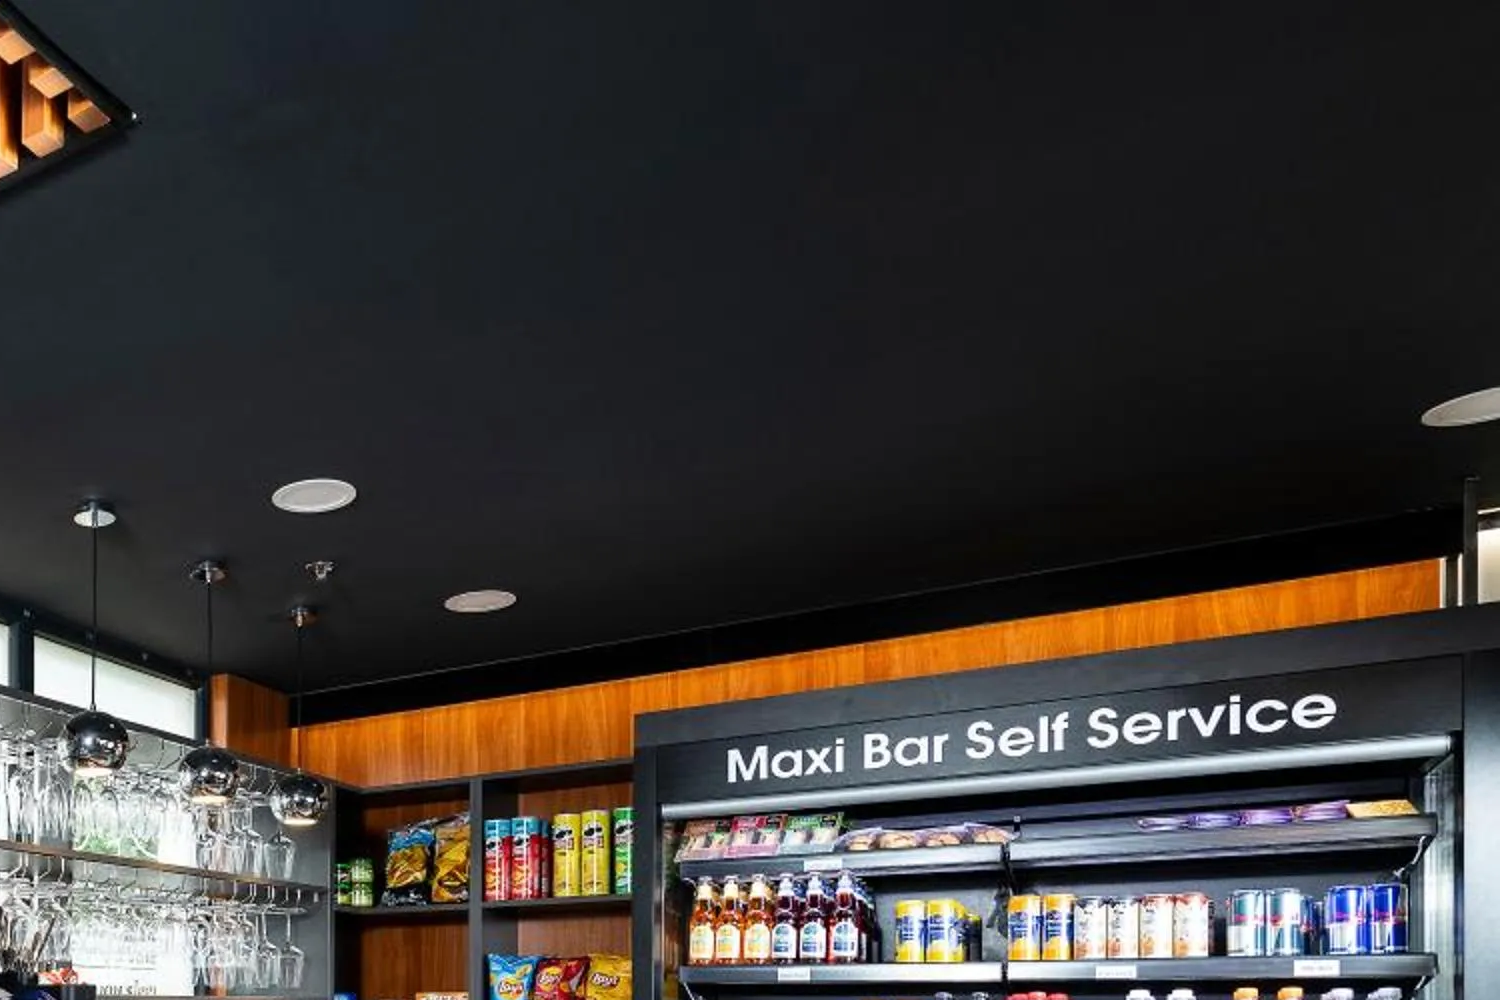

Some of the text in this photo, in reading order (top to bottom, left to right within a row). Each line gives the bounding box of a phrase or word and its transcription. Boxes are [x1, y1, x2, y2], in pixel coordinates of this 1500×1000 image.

[727, 694, 1337, 783] Maxi Bar Self Service
